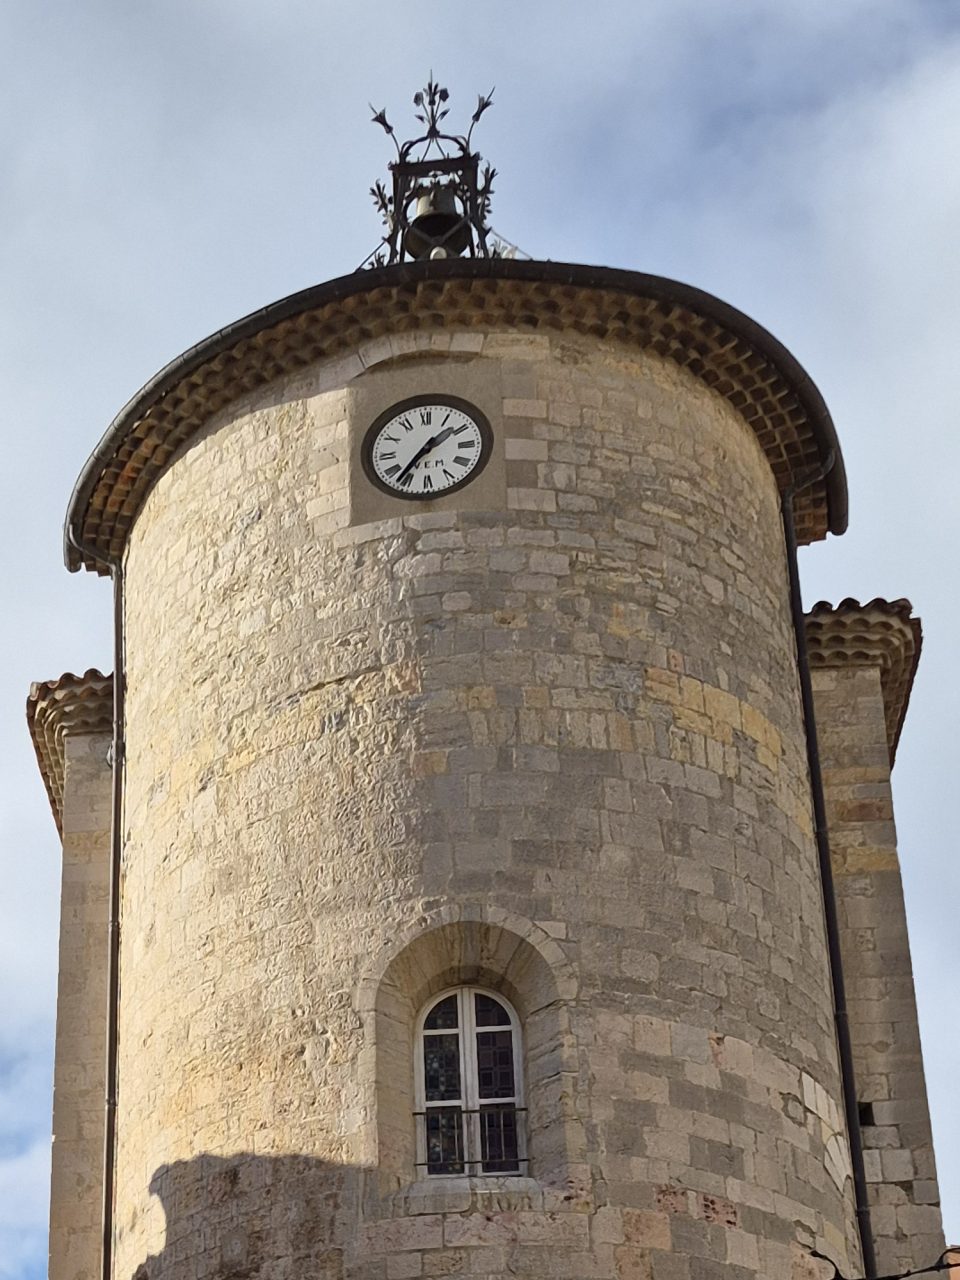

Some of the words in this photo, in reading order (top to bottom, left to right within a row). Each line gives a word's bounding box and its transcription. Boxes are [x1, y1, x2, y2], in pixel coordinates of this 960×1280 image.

[398, 416, 414, 433] XI
[420, 411, 432, 426] XII
[383, 433, 401, 444] X
